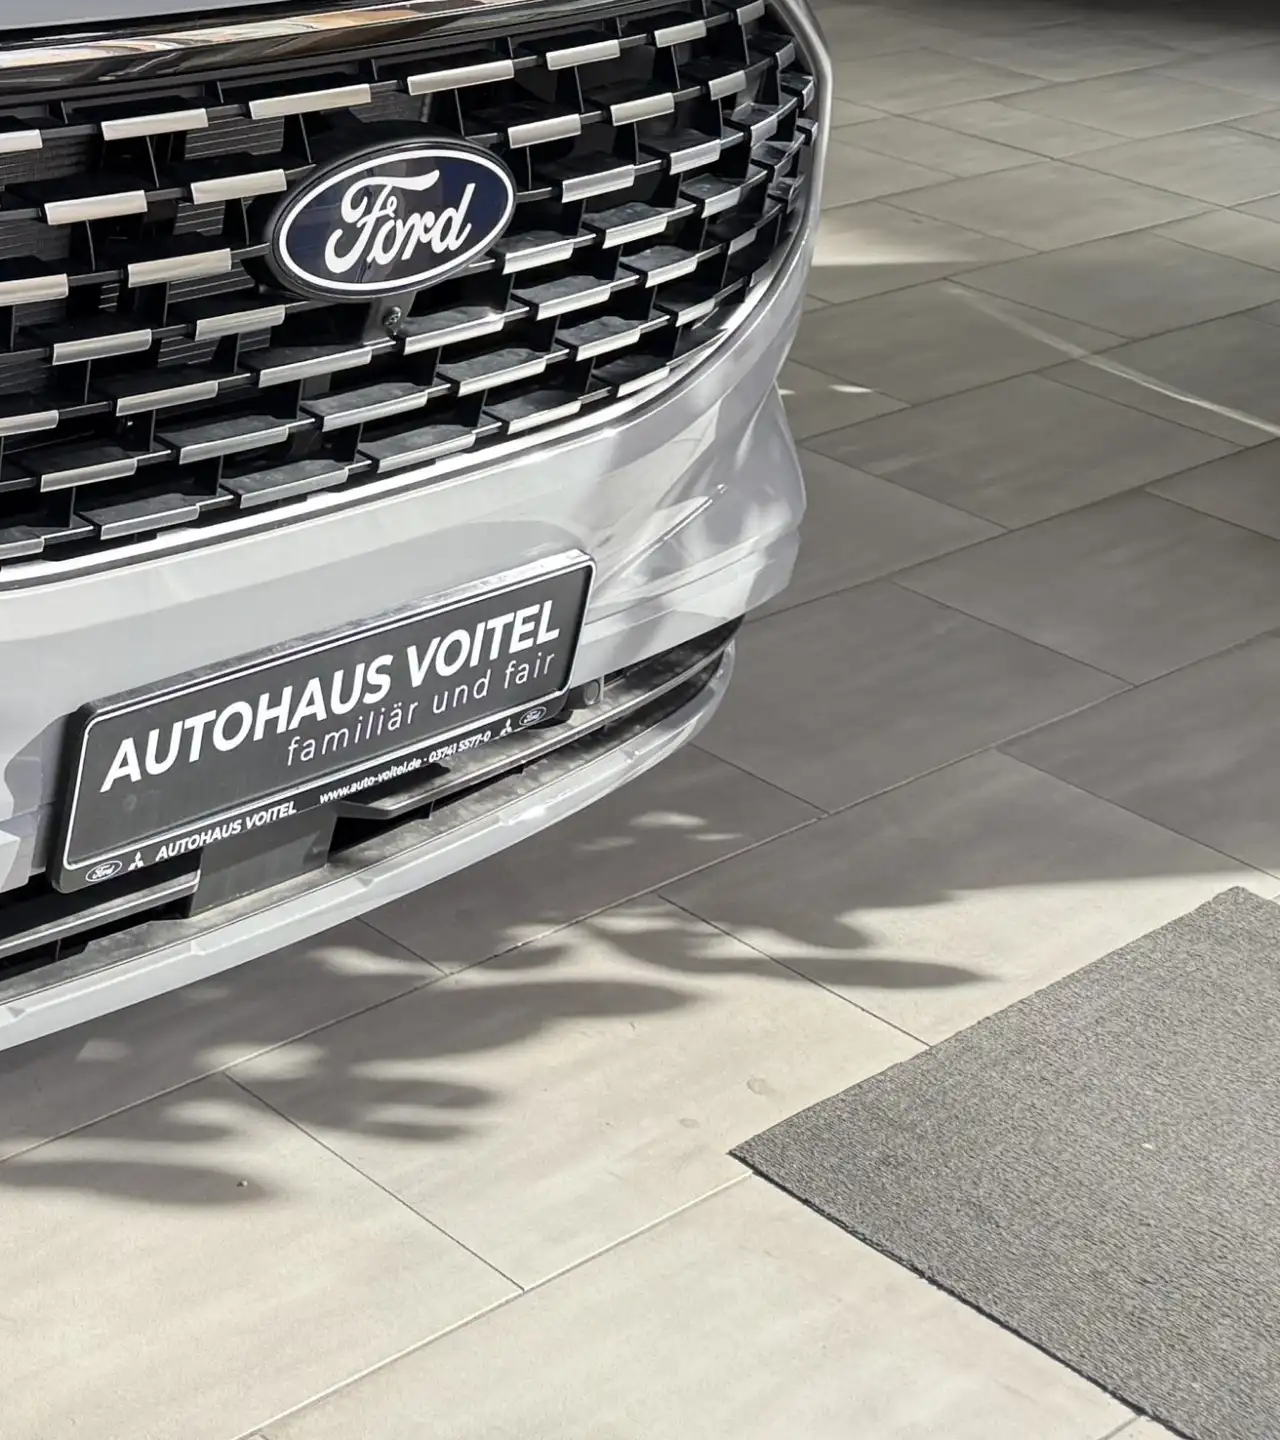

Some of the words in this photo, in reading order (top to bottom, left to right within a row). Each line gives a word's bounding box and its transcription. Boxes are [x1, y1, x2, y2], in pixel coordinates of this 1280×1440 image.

[325, 170, 476, 273] Ford
[99, 654, 394, 793] AUTOHAUS
[406, 599, 560, 688] VOITEL
[286, 701, 419, 766] familiär
[432, 668, 492, 714] und
[503, 651, 556, 689] fair
[155, 817, 243, 862] AUTOHAUS
[246, 800, 297, 830] VOITEL
[319, 756, 422, 805] www.auto-voitel.de
